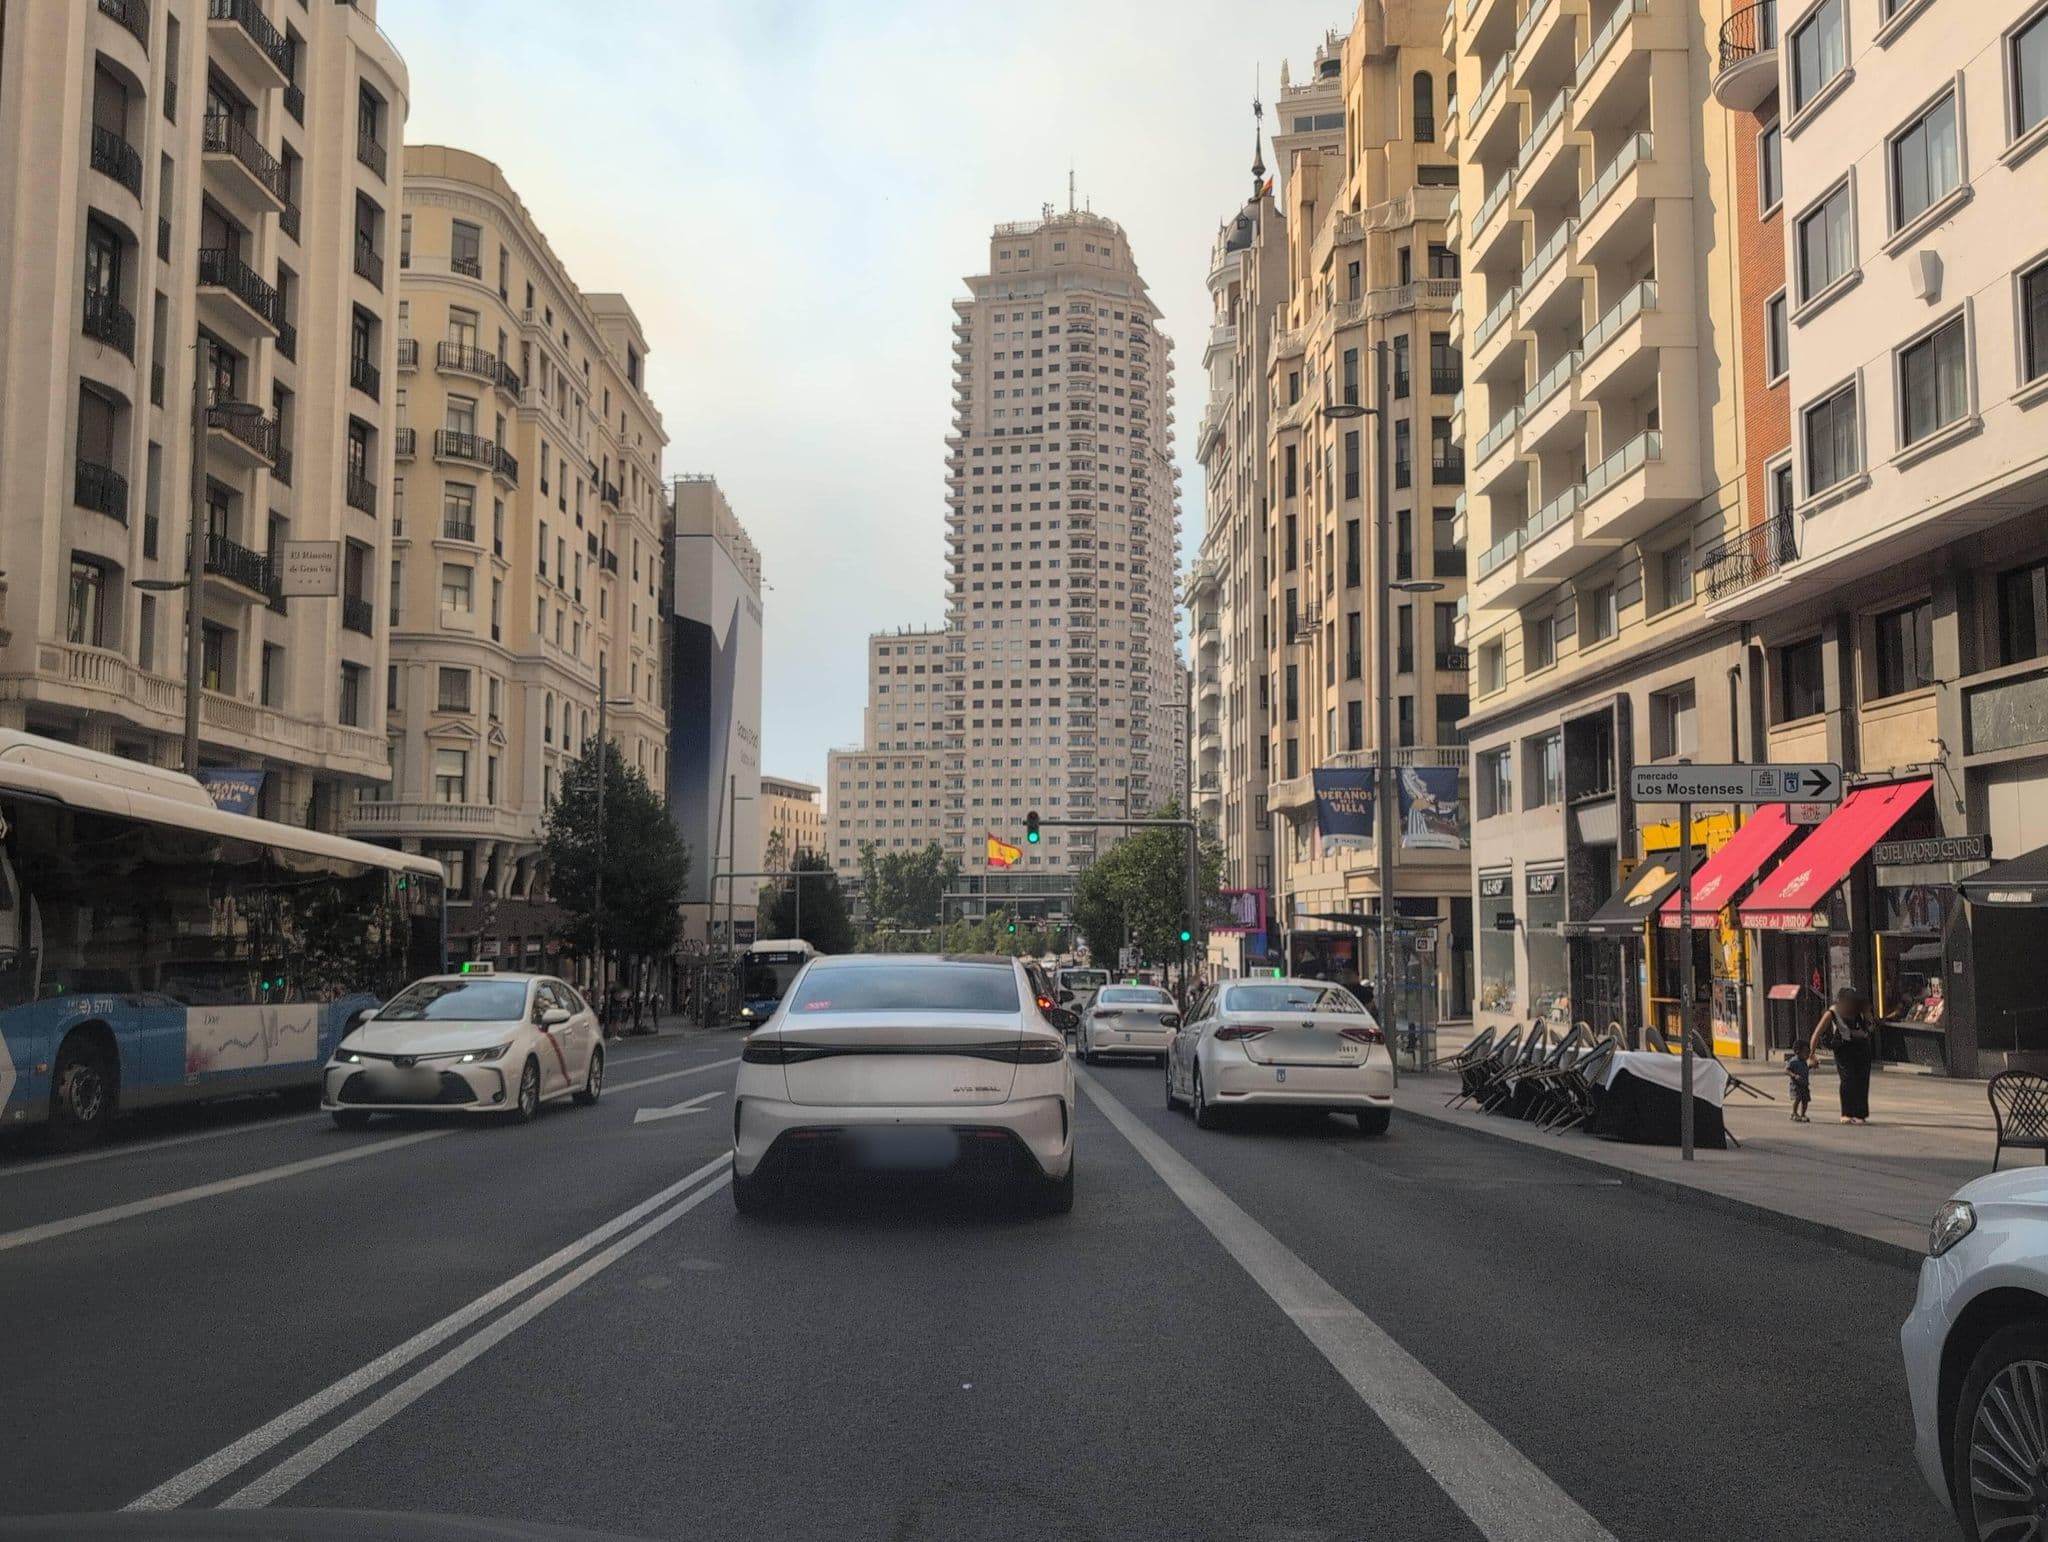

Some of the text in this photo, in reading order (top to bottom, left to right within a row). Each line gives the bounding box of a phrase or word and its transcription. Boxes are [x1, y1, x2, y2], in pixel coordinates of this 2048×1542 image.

[1637, 772, 1678, 781] mercado
[1637, 783, 1662, 795] Los
[1667, 783, 1744, 795] Mostenses
[1330, 802, 1366, 814] VILLA
[1875, 838, 1980, 861] HOTEL MADRID CENTRO
